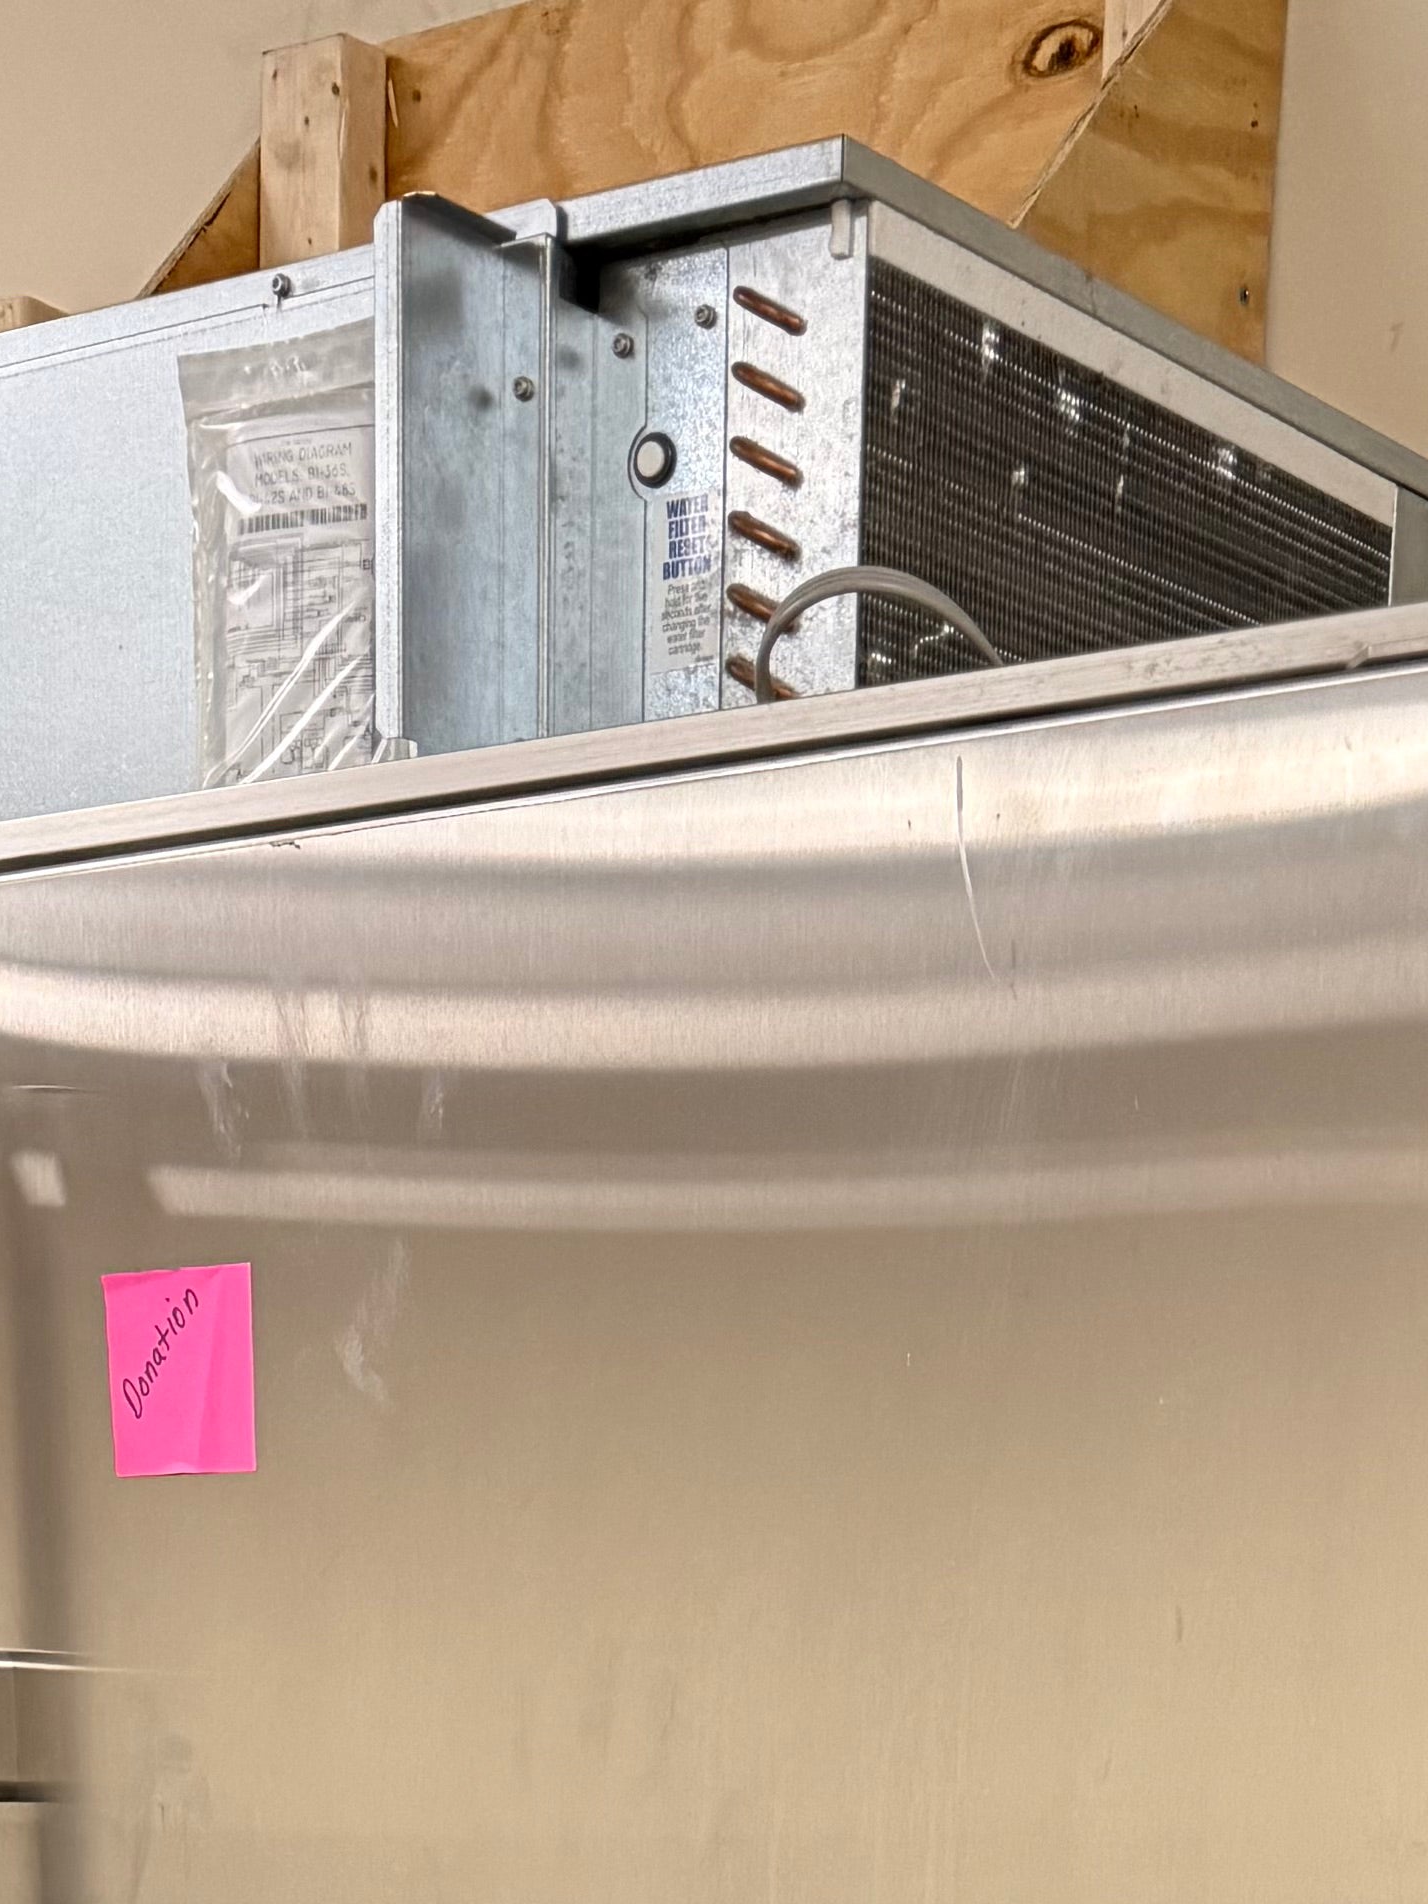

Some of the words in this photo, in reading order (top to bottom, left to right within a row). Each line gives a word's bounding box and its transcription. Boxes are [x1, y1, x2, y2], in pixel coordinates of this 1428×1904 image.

[298, 442, 352, 462] DIAGRAM
[666, 493, 708, 519] WATER
[668, 515, 706, 540] FILTER
[668, 535, 706, 559] RESET
[663, 554, 712, 580] BUTTON
[123, 1288, 199, 1420] Donation
